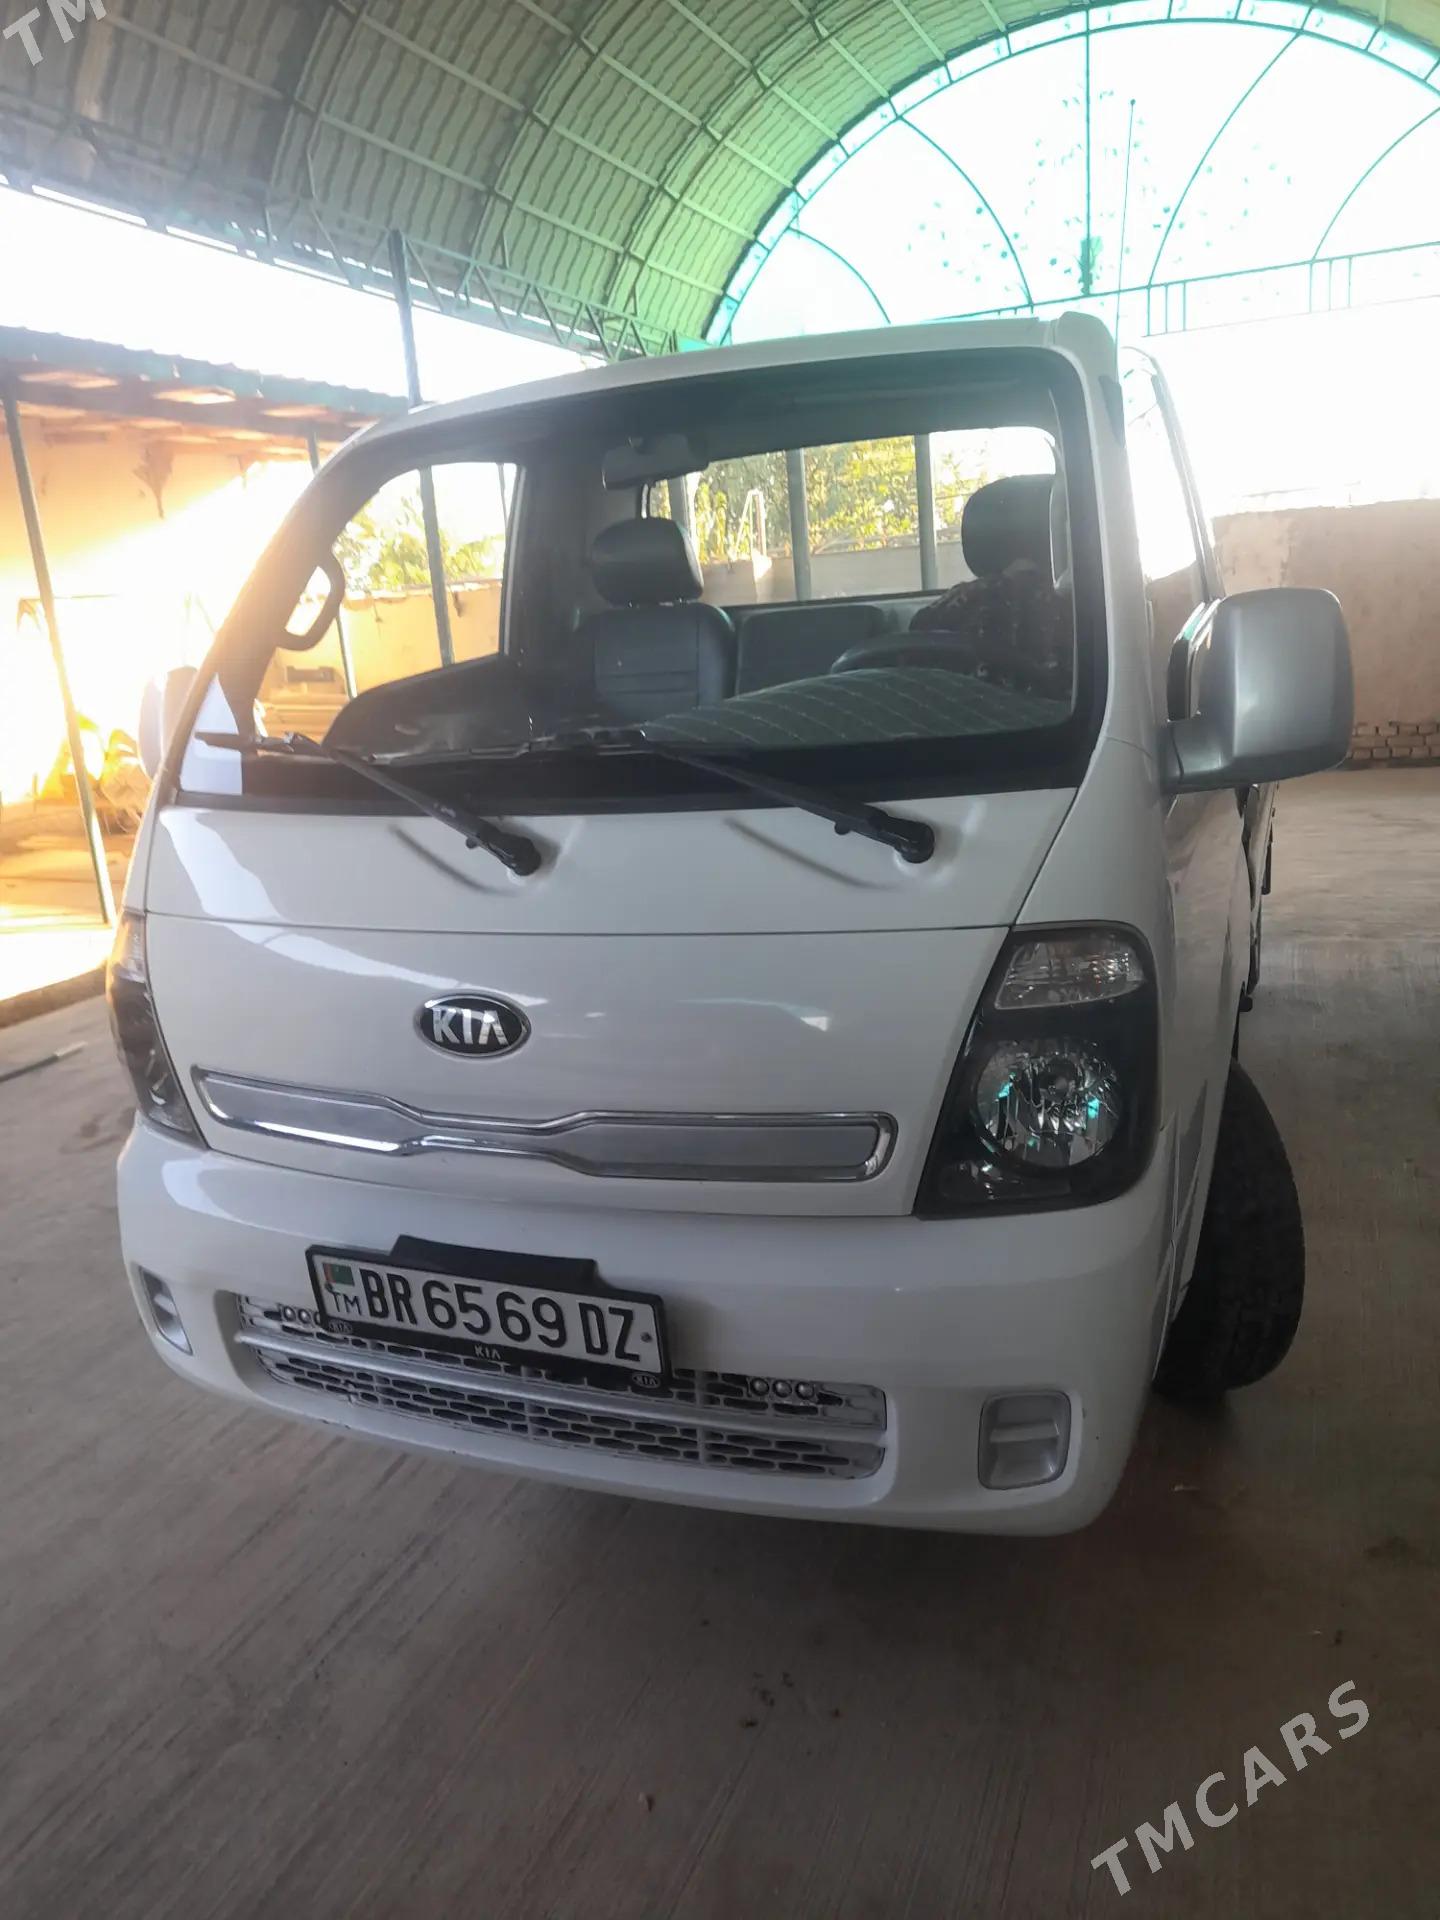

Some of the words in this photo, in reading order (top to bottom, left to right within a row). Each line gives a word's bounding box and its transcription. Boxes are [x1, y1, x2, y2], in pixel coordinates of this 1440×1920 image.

[432, 1005, 509, 1045] KIA
[327, 1286, 362, 1316] TM
[474, 1344, 501, 1360] KIA
